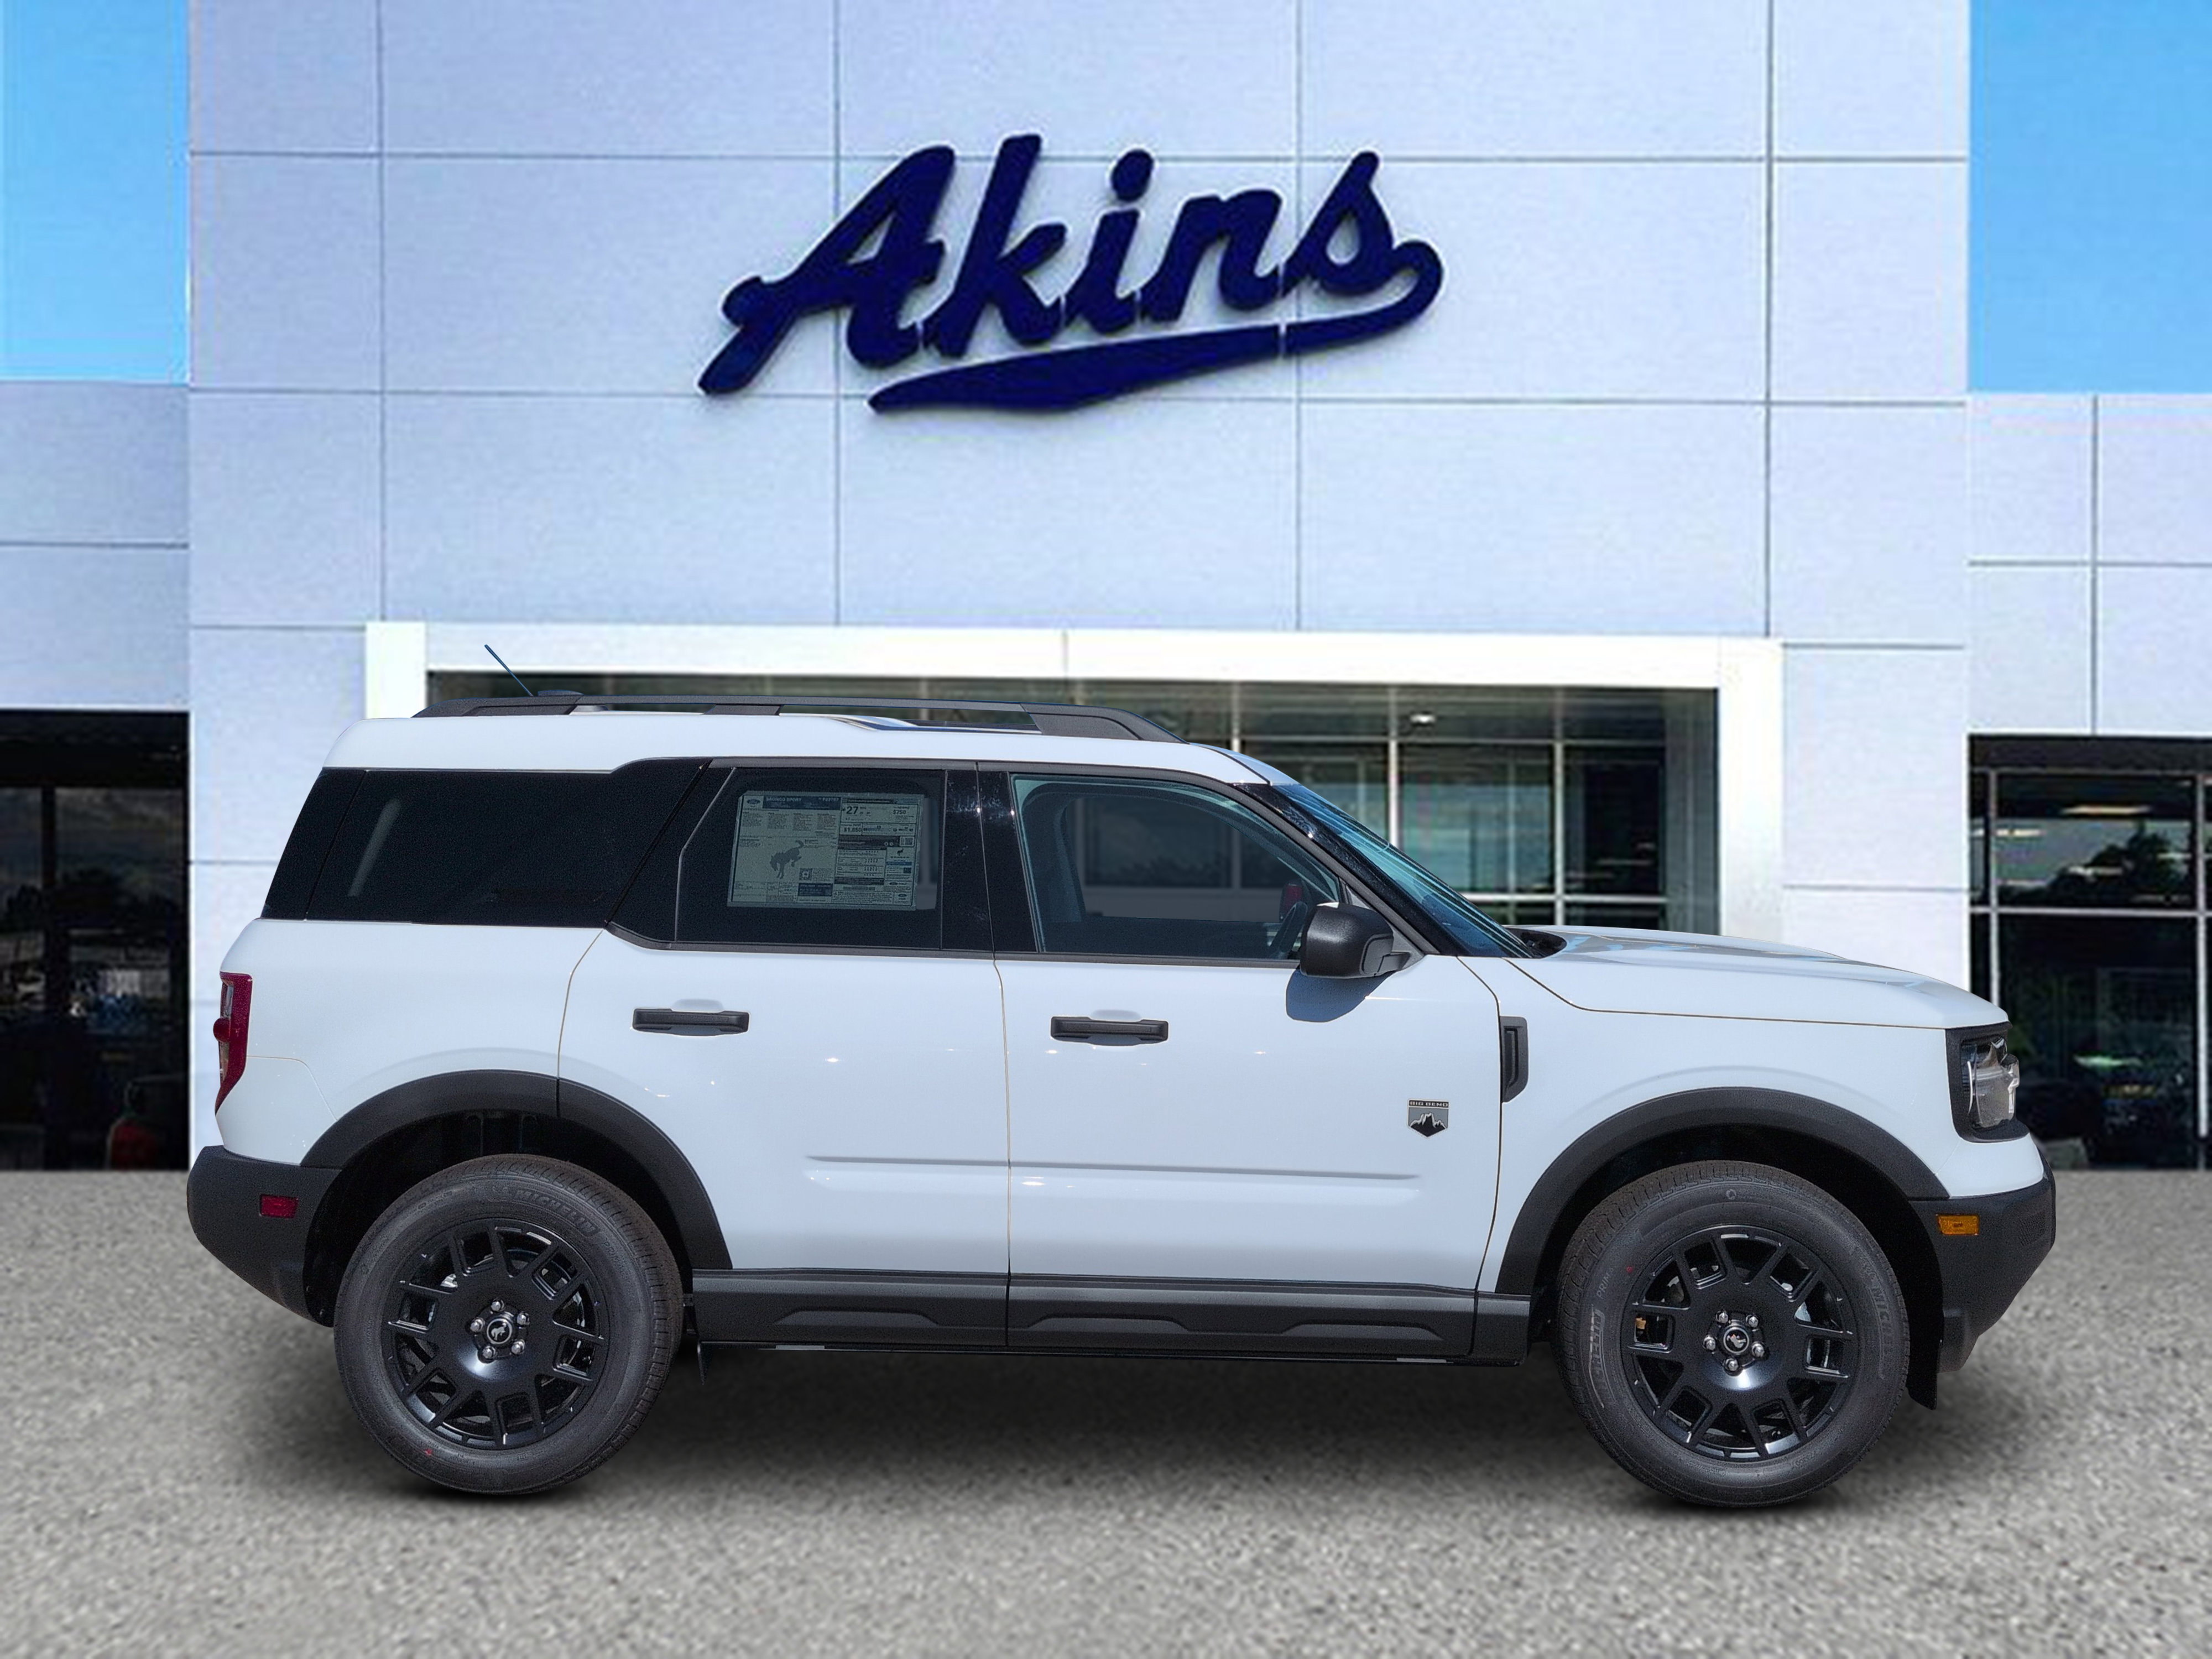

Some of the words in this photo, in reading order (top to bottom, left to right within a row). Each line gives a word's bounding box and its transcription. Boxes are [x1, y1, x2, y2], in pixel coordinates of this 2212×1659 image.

[698, 134, 1443, 412] Akins
[846, 806, 859, 815] 27
[514, 1190, 596, 1233] MICHELIN
